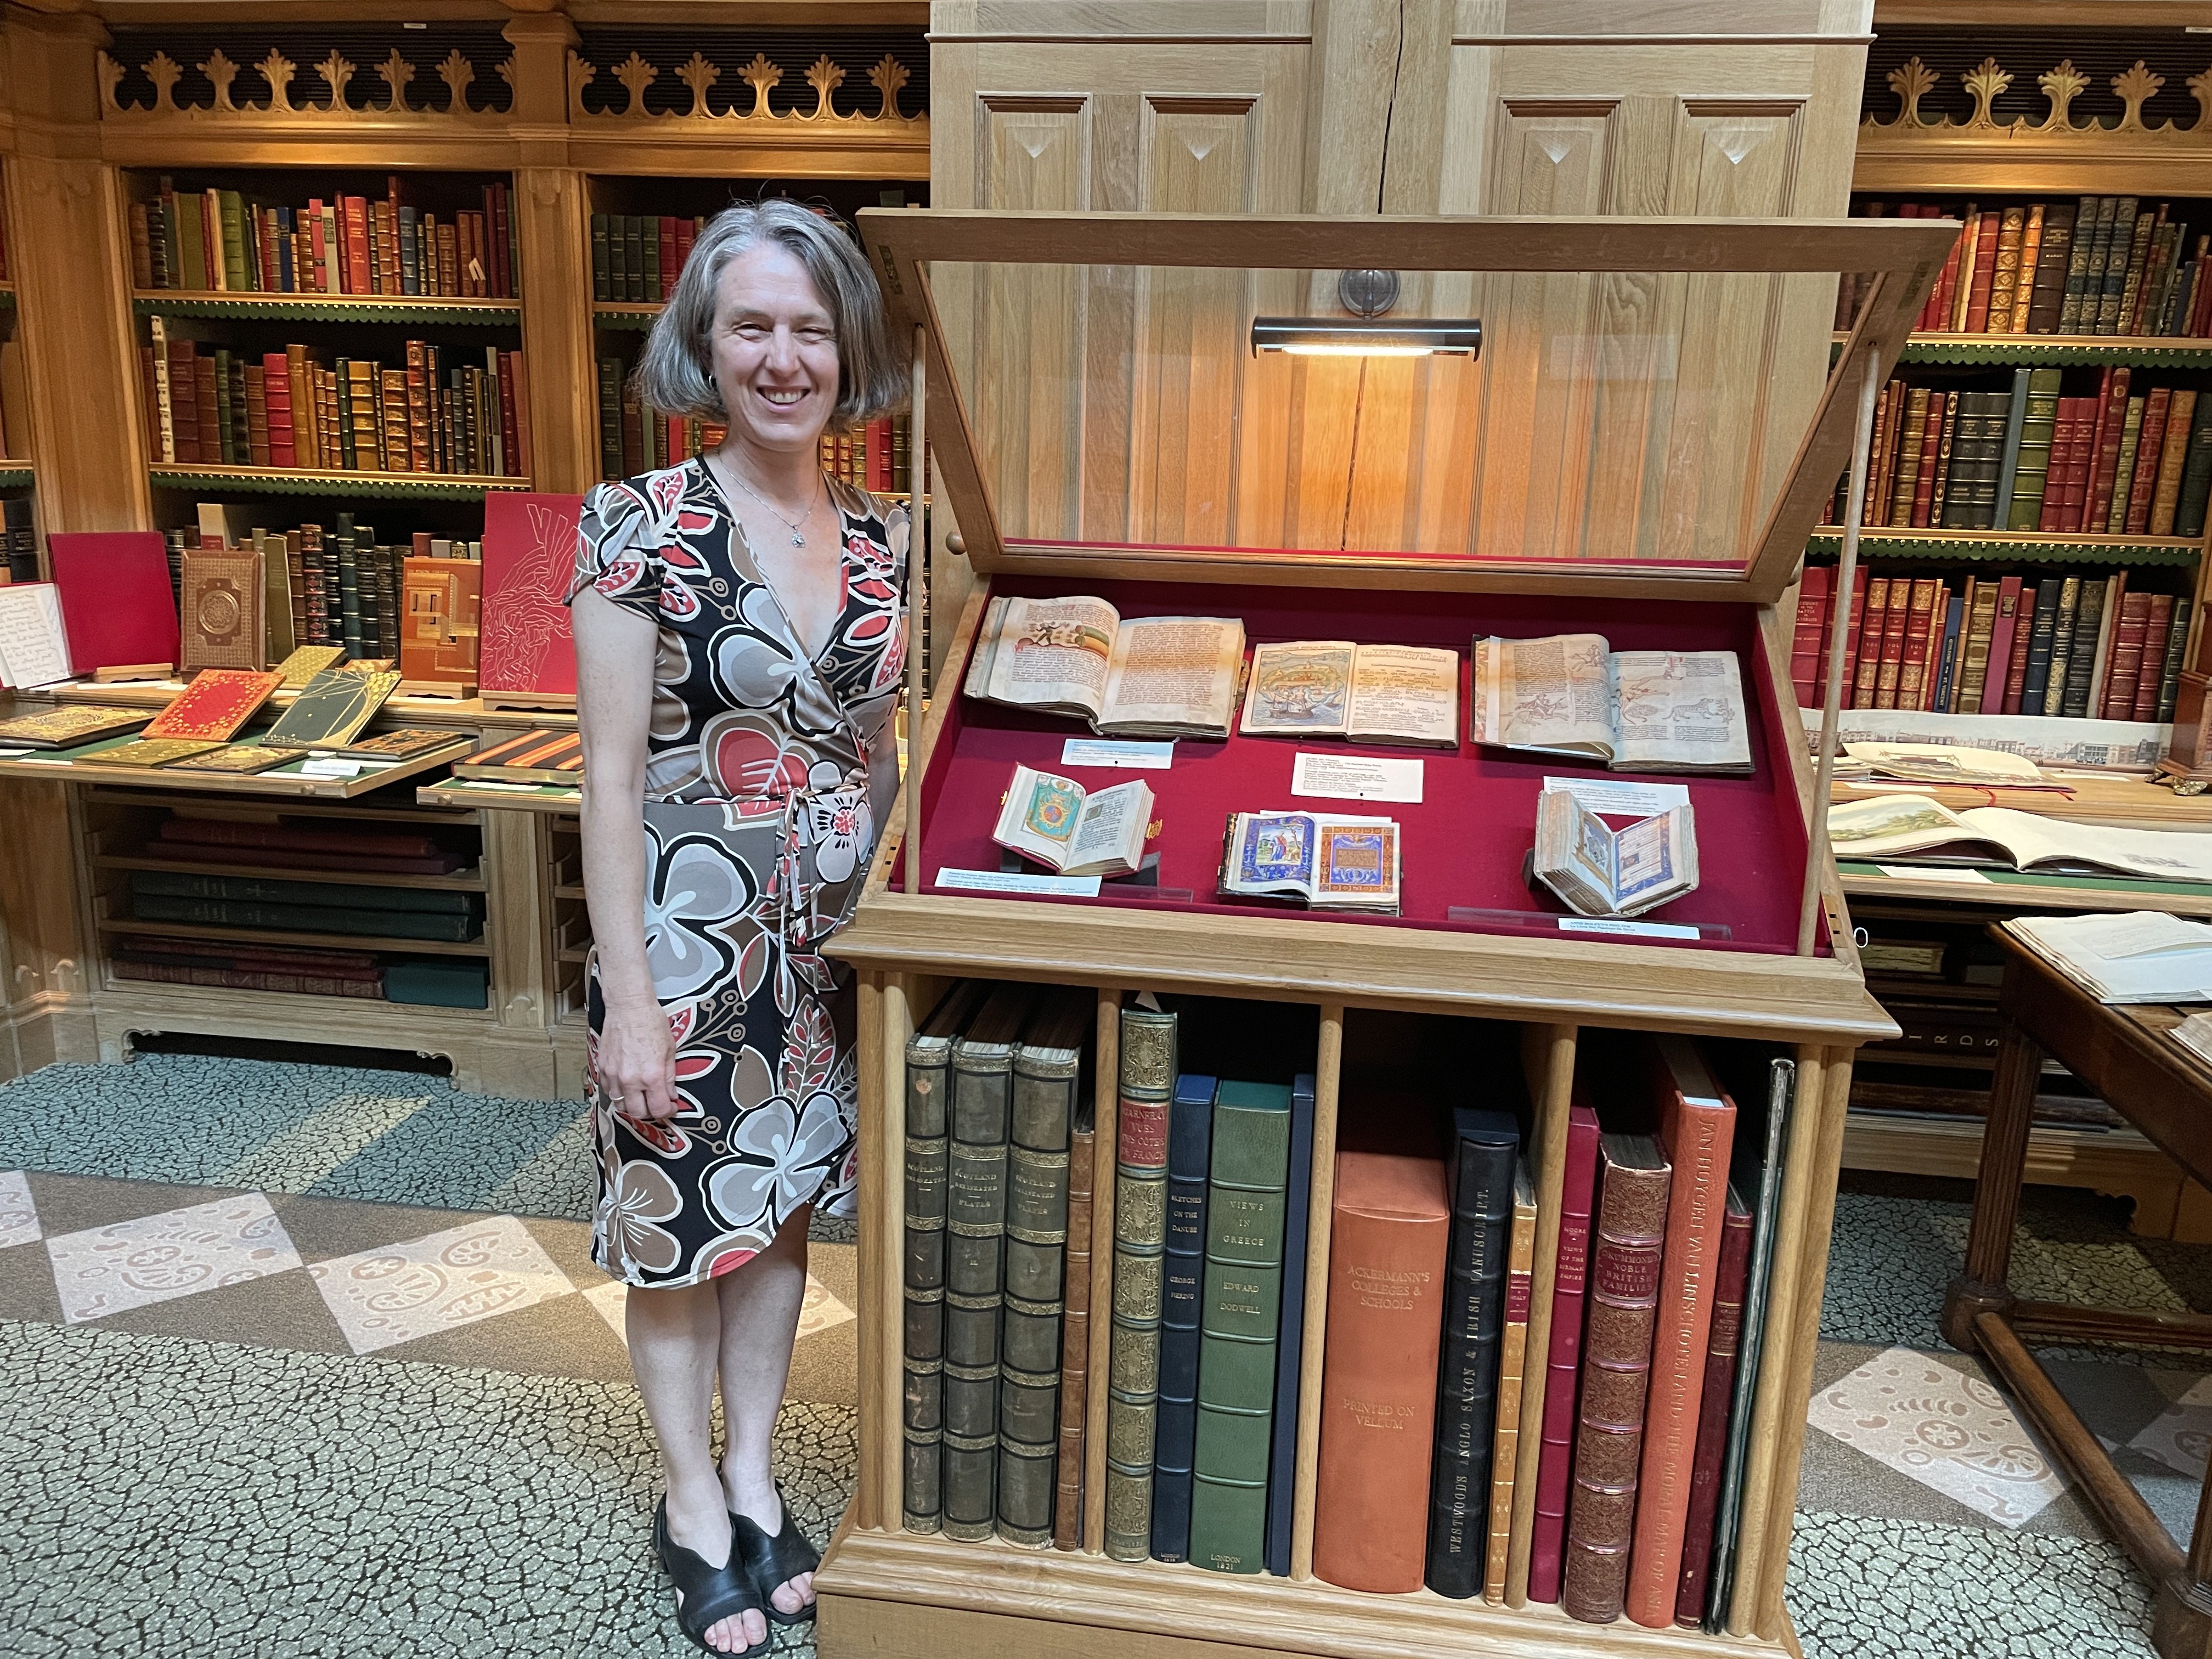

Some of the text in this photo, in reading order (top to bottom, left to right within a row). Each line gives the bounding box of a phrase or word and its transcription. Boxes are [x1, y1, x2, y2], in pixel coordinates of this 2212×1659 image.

[1909, 1035, 1999, 1046] IRDS
[1699, 1119, 1715, 1151] JAN
[907, 1163, 944, 1172] SCOTLAND
[955, 1169, 996, 1180] SCOTLAND
[1015, 1175, 1057, 1188] SCOTLAND
[1171, 1195, 1202, 1203] SKETCHES
[1230, 1200, 1264, 1211] VIEWS
[1239, 1219, 1251, 1227] IN
[1172, 1225, 1198, 1233] DANUBE
[1223, 1235, 1264, 1246] GREECE
[1347, 1265, 1430, 1282] ACKERMANN'S
[1613, 1263, 1646, 1273] NOBLE
[1170, 1276, 1195, 1284] GEORGE
[1606, 1270, 1652, 1282] BRITISH
[1223, 1282, 1259, 1293] EDWARD
[1352, 1280, 1422, 1296] COLLEGES &
[1602, 1279, 1652, 1291] FAMILIES
[1220, 1302, 1260, 1314] DODWELL
[1361, 1296, 1413, 1310] SCHOOLS
[1466, 1296, 1480, 1339] IRISH
[1466, 1350, 1477, 1359] &
[1461, 1367, 1476, 1412] SAXON
[1343, 1398, 1415, 1417] PRINTED ON
[1356, 1414, 1404, 1429] VELLUM
[1459, 1423, 1471, 1466] ANGLO
[1211, 1554, 1241, 1564] LONDON
[1217, 1562, 1233, 1570] 1821
